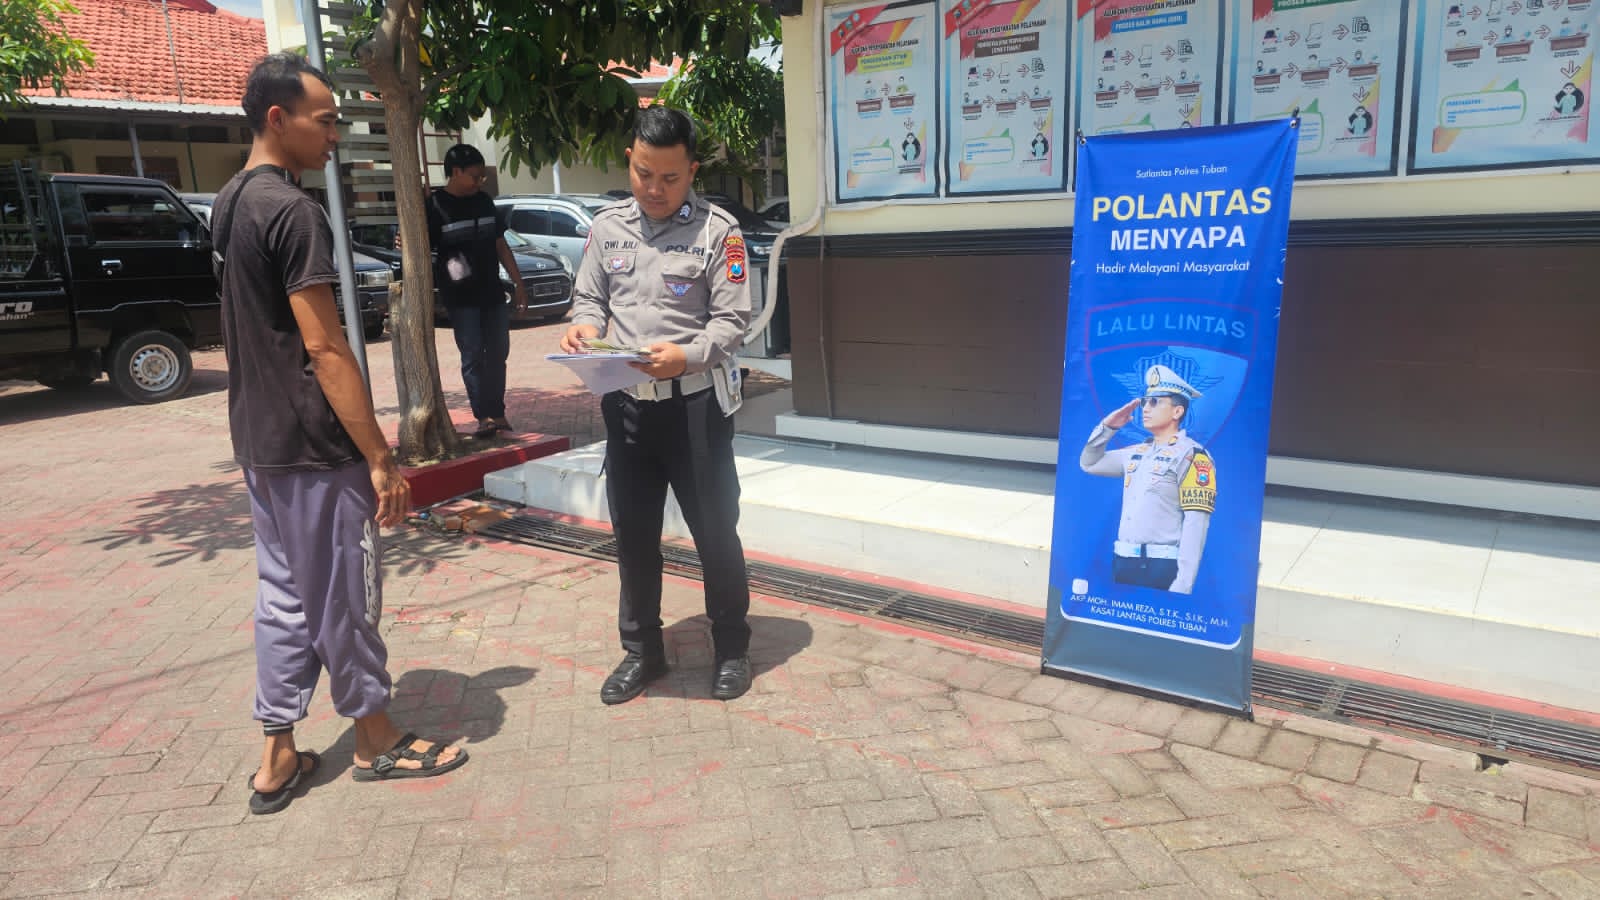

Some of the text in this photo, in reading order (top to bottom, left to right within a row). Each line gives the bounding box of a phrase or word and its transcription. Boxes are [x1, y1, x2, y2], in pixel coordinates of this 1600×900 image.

[1136, 165, 1227, 178] Satlantas Polres Tuban
[1092, 186, 1272, 222] POLANTAS
[604, 241, 619, 250] DWI
[1110, 225, 1246, 251] MENYAPA
[665, 244, 704, 256] POLRI
[1096, 259, 1250, 276] Hadir Melayani Masyarakat
[1097, 313, 1246, 339] LALU LINTAS
[1111, 599, 1134, 611] IMAM
[1091, 605, 1208, 633] KASAT LANTAS POLRES TUBAN
